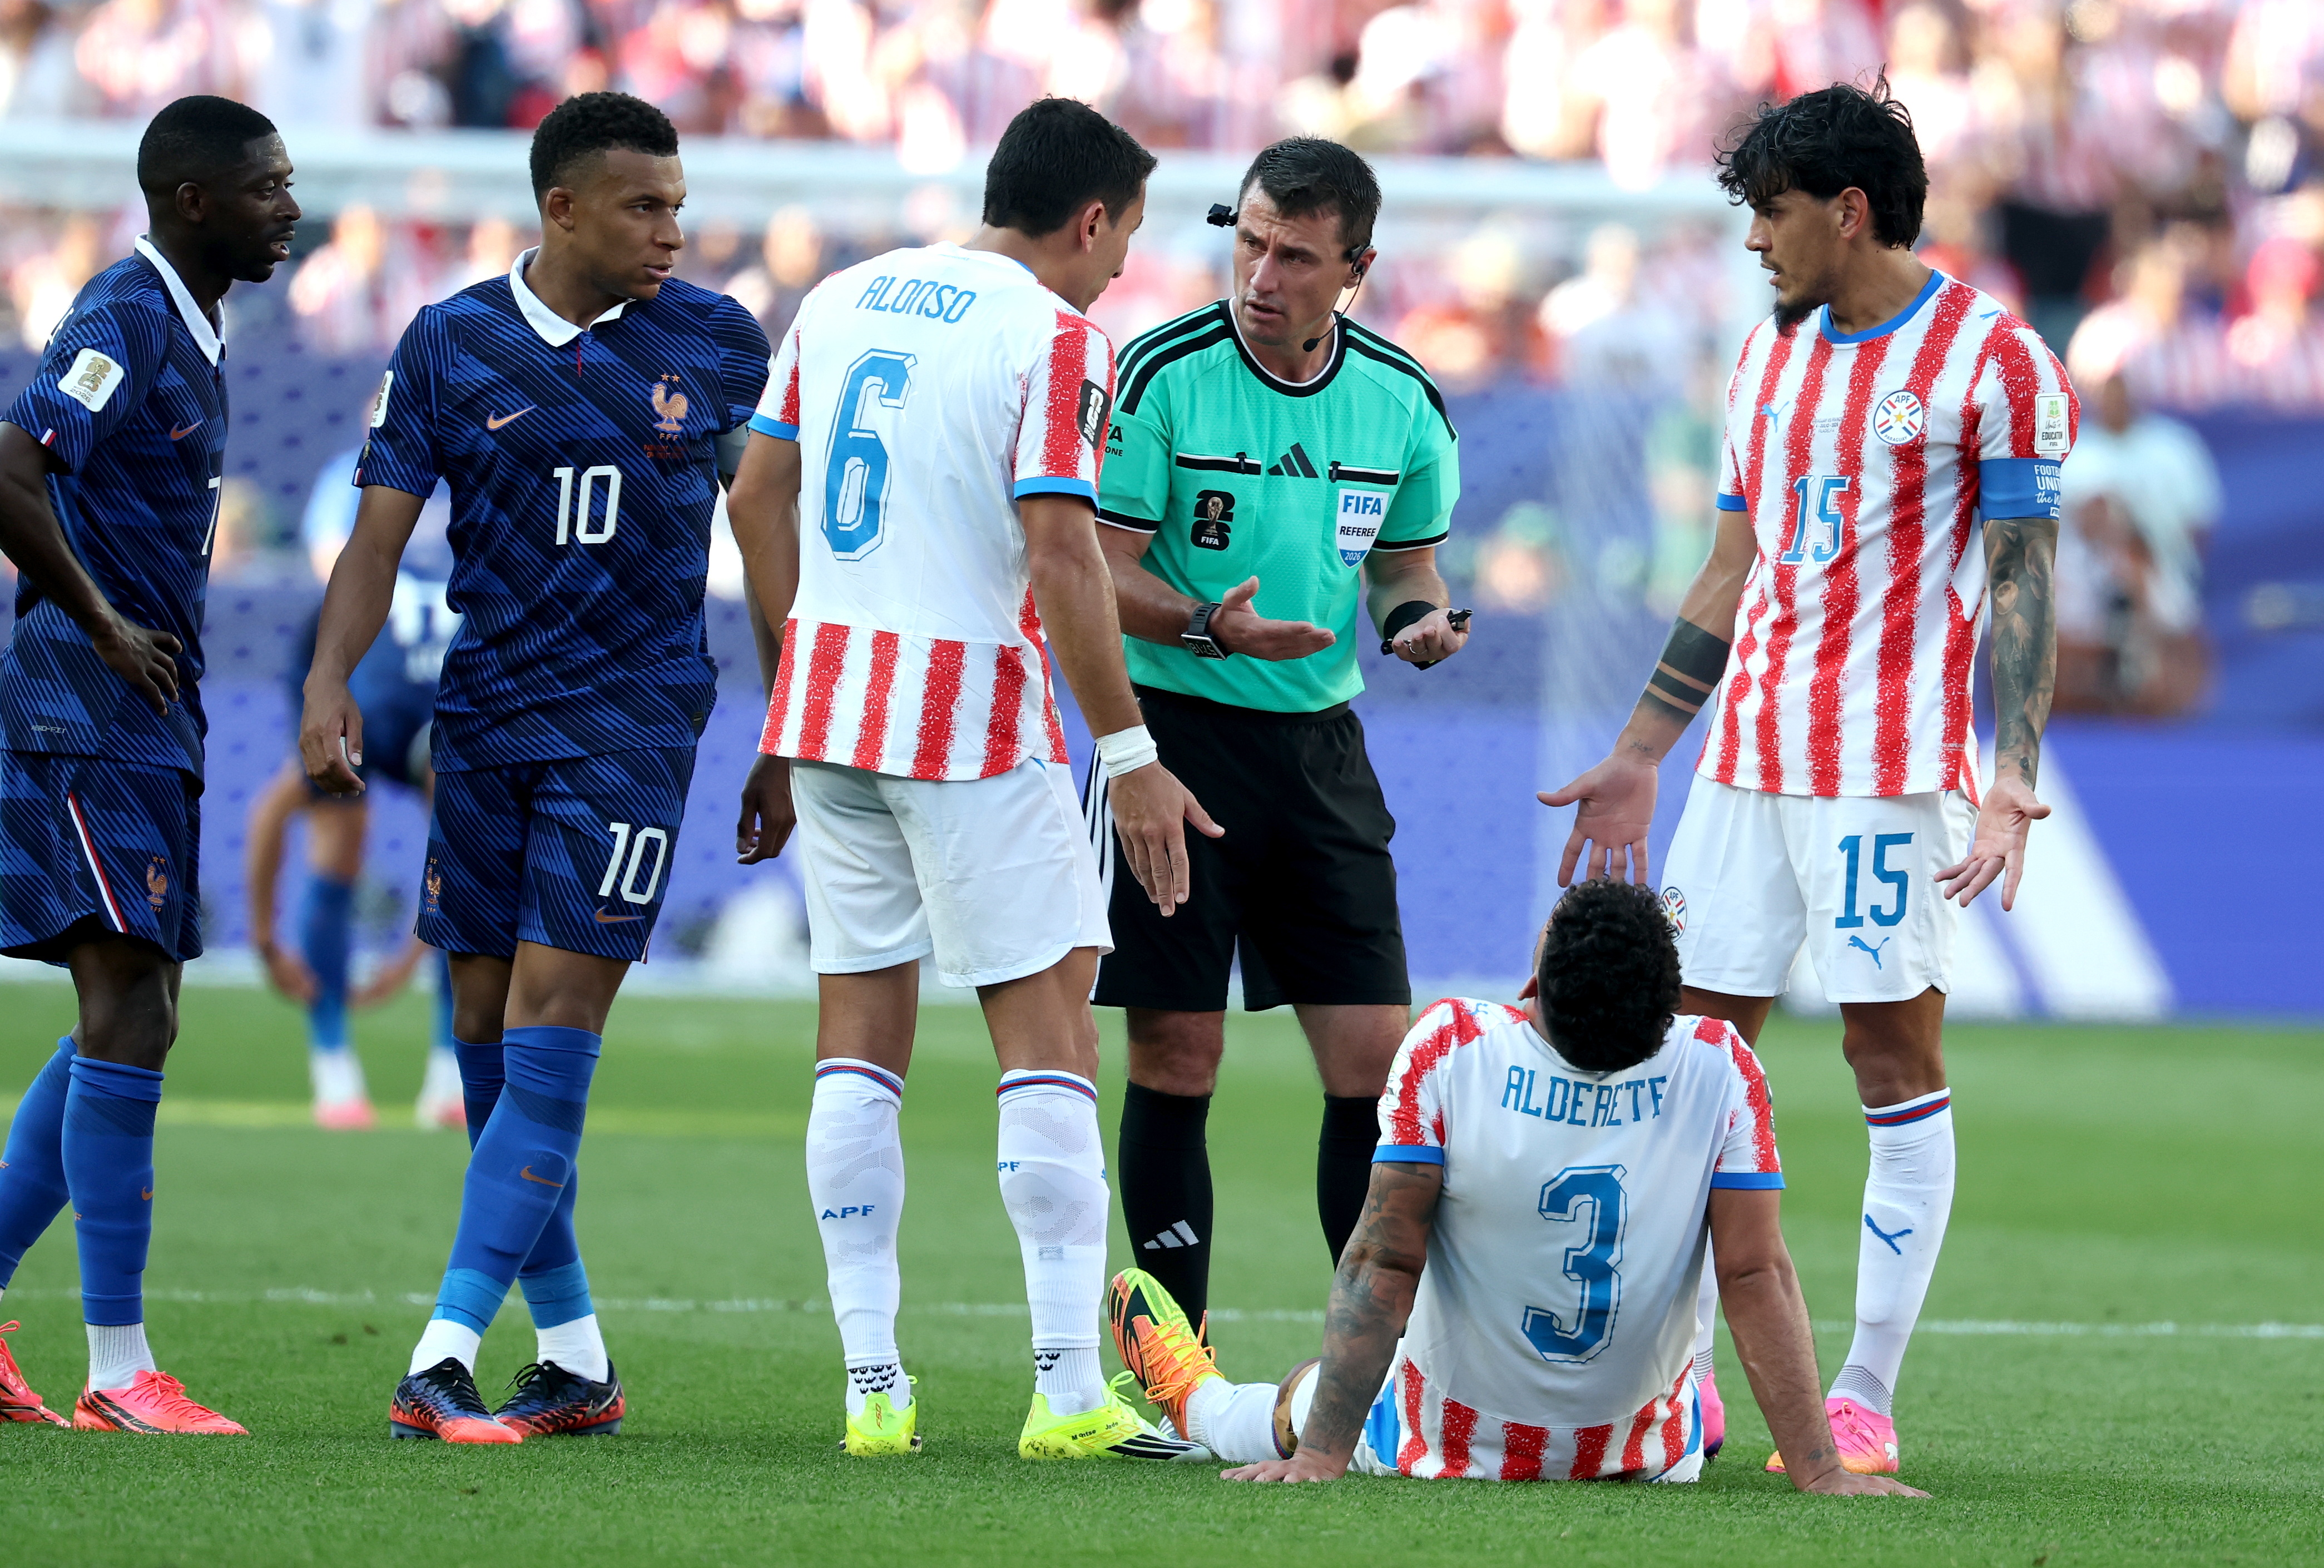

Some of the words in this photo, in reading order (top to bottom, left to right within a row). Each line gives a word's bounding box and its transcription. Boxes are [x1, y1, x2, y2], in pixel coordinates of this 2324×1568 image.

[855, 276, 977, 324] ALONSO
[70, 388, 91, 403] 2026
[1895, 395, 1911, 403] APF
[660, 433, 679, 441] FFF
[820, 348, 918, 562] 6
[553, 465, 623, 545] 10
[1342, 494, 1381, 515] FIFA
[2035, 490, 2053, 504] the
[201, 475, 221, 555] 7
[1780, 475, 1852, 565] 15
[1339, 525, 1377, 537] REFEREE
[1201, 535, 1220, 545] FIFA
[1344, 552, 1362, 561] 2026
[31, 725, 67, 734] AERO-FIT
[598, 822, 668, 905] 10
[1835, 832, 1915, 929] 15
[1669, 891, 1679, 901] APF
[997, 1161, 1020, 1172] PF
[821, 1204, 875, 1220] APF
[1520, 1164, 1628, 1364] 3
[1071, 1428, 1097, 1441] Montse
[1105, 1421, 1119, 1430] Jade
